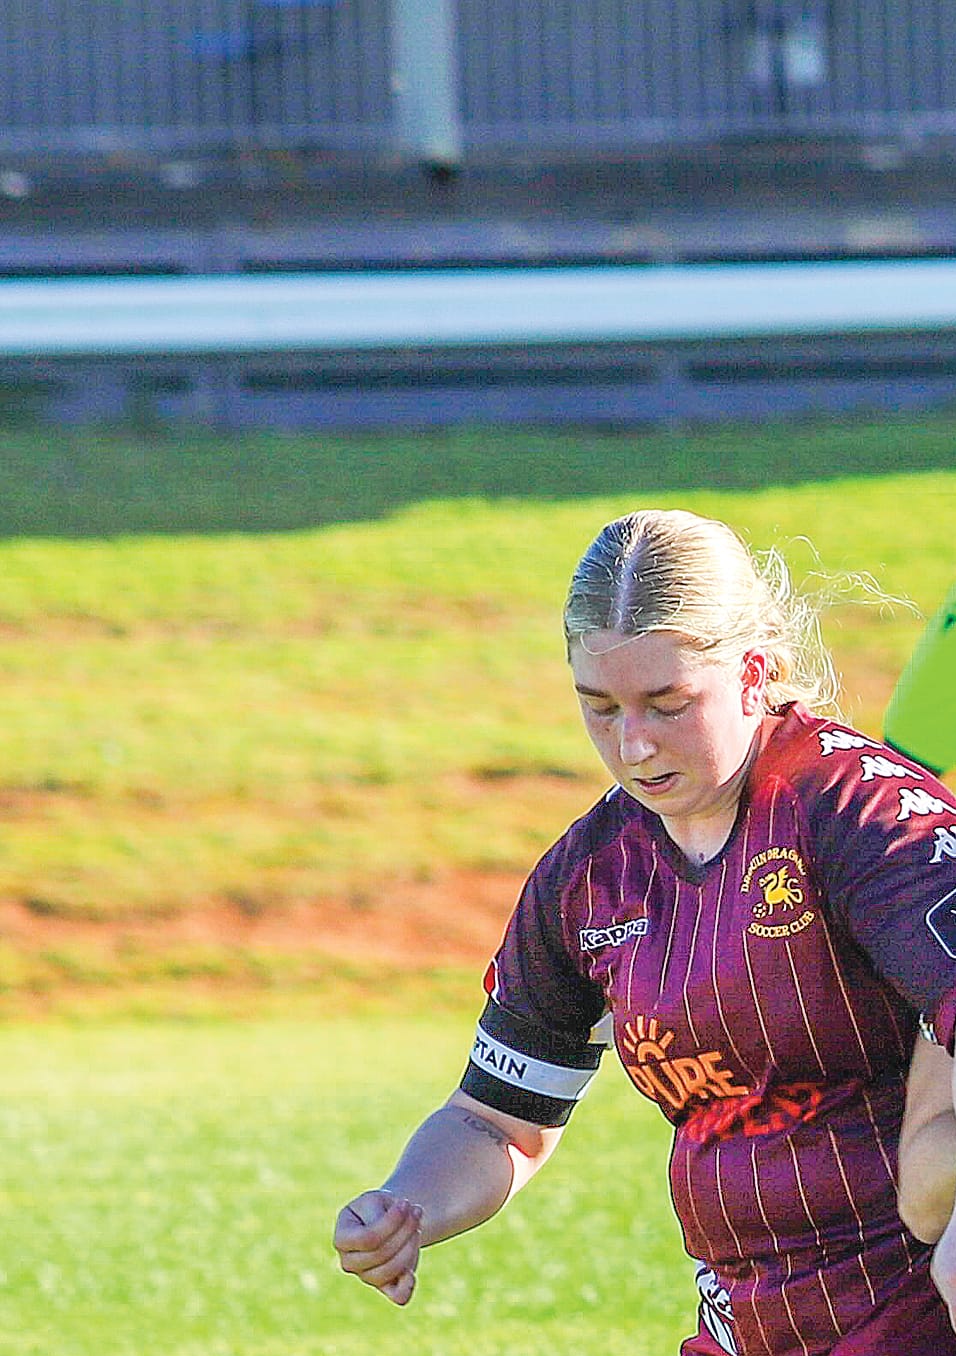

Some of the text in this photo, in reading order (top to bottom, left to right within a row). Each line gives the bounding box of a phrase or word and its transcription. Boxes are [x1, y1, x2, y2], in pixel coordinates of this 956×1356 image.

[579, 918, 649, 951] Kappa
[748, 910, 815, 937] SOCCER CLUB
[474, 1035, 528, 1080] TAIN
